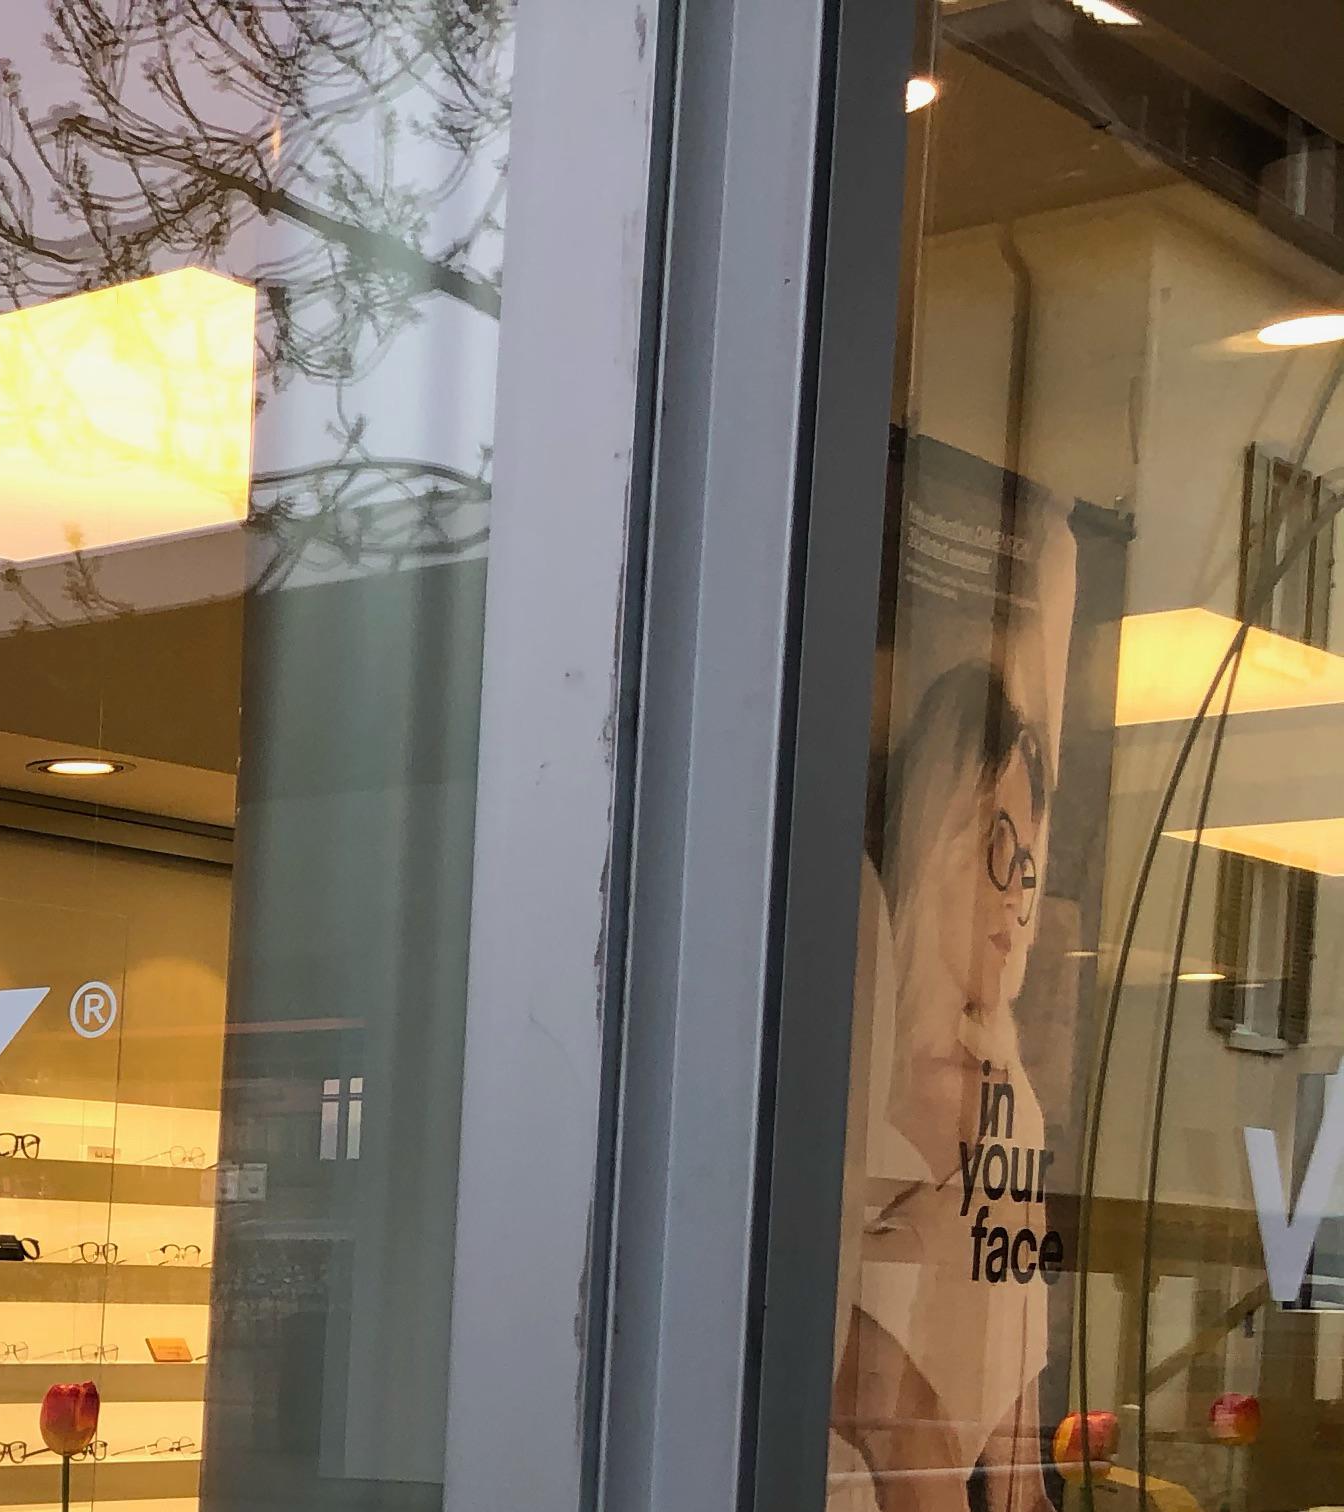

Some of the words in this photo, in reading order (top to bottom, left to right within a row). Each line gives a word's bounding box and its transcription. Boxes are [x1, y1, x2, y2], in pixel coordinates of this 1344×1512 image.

[978, 1059, 1015, 1139] in
[959, 1140, 1055, 1217] your
[970, 1205, 1064, 1285] face
